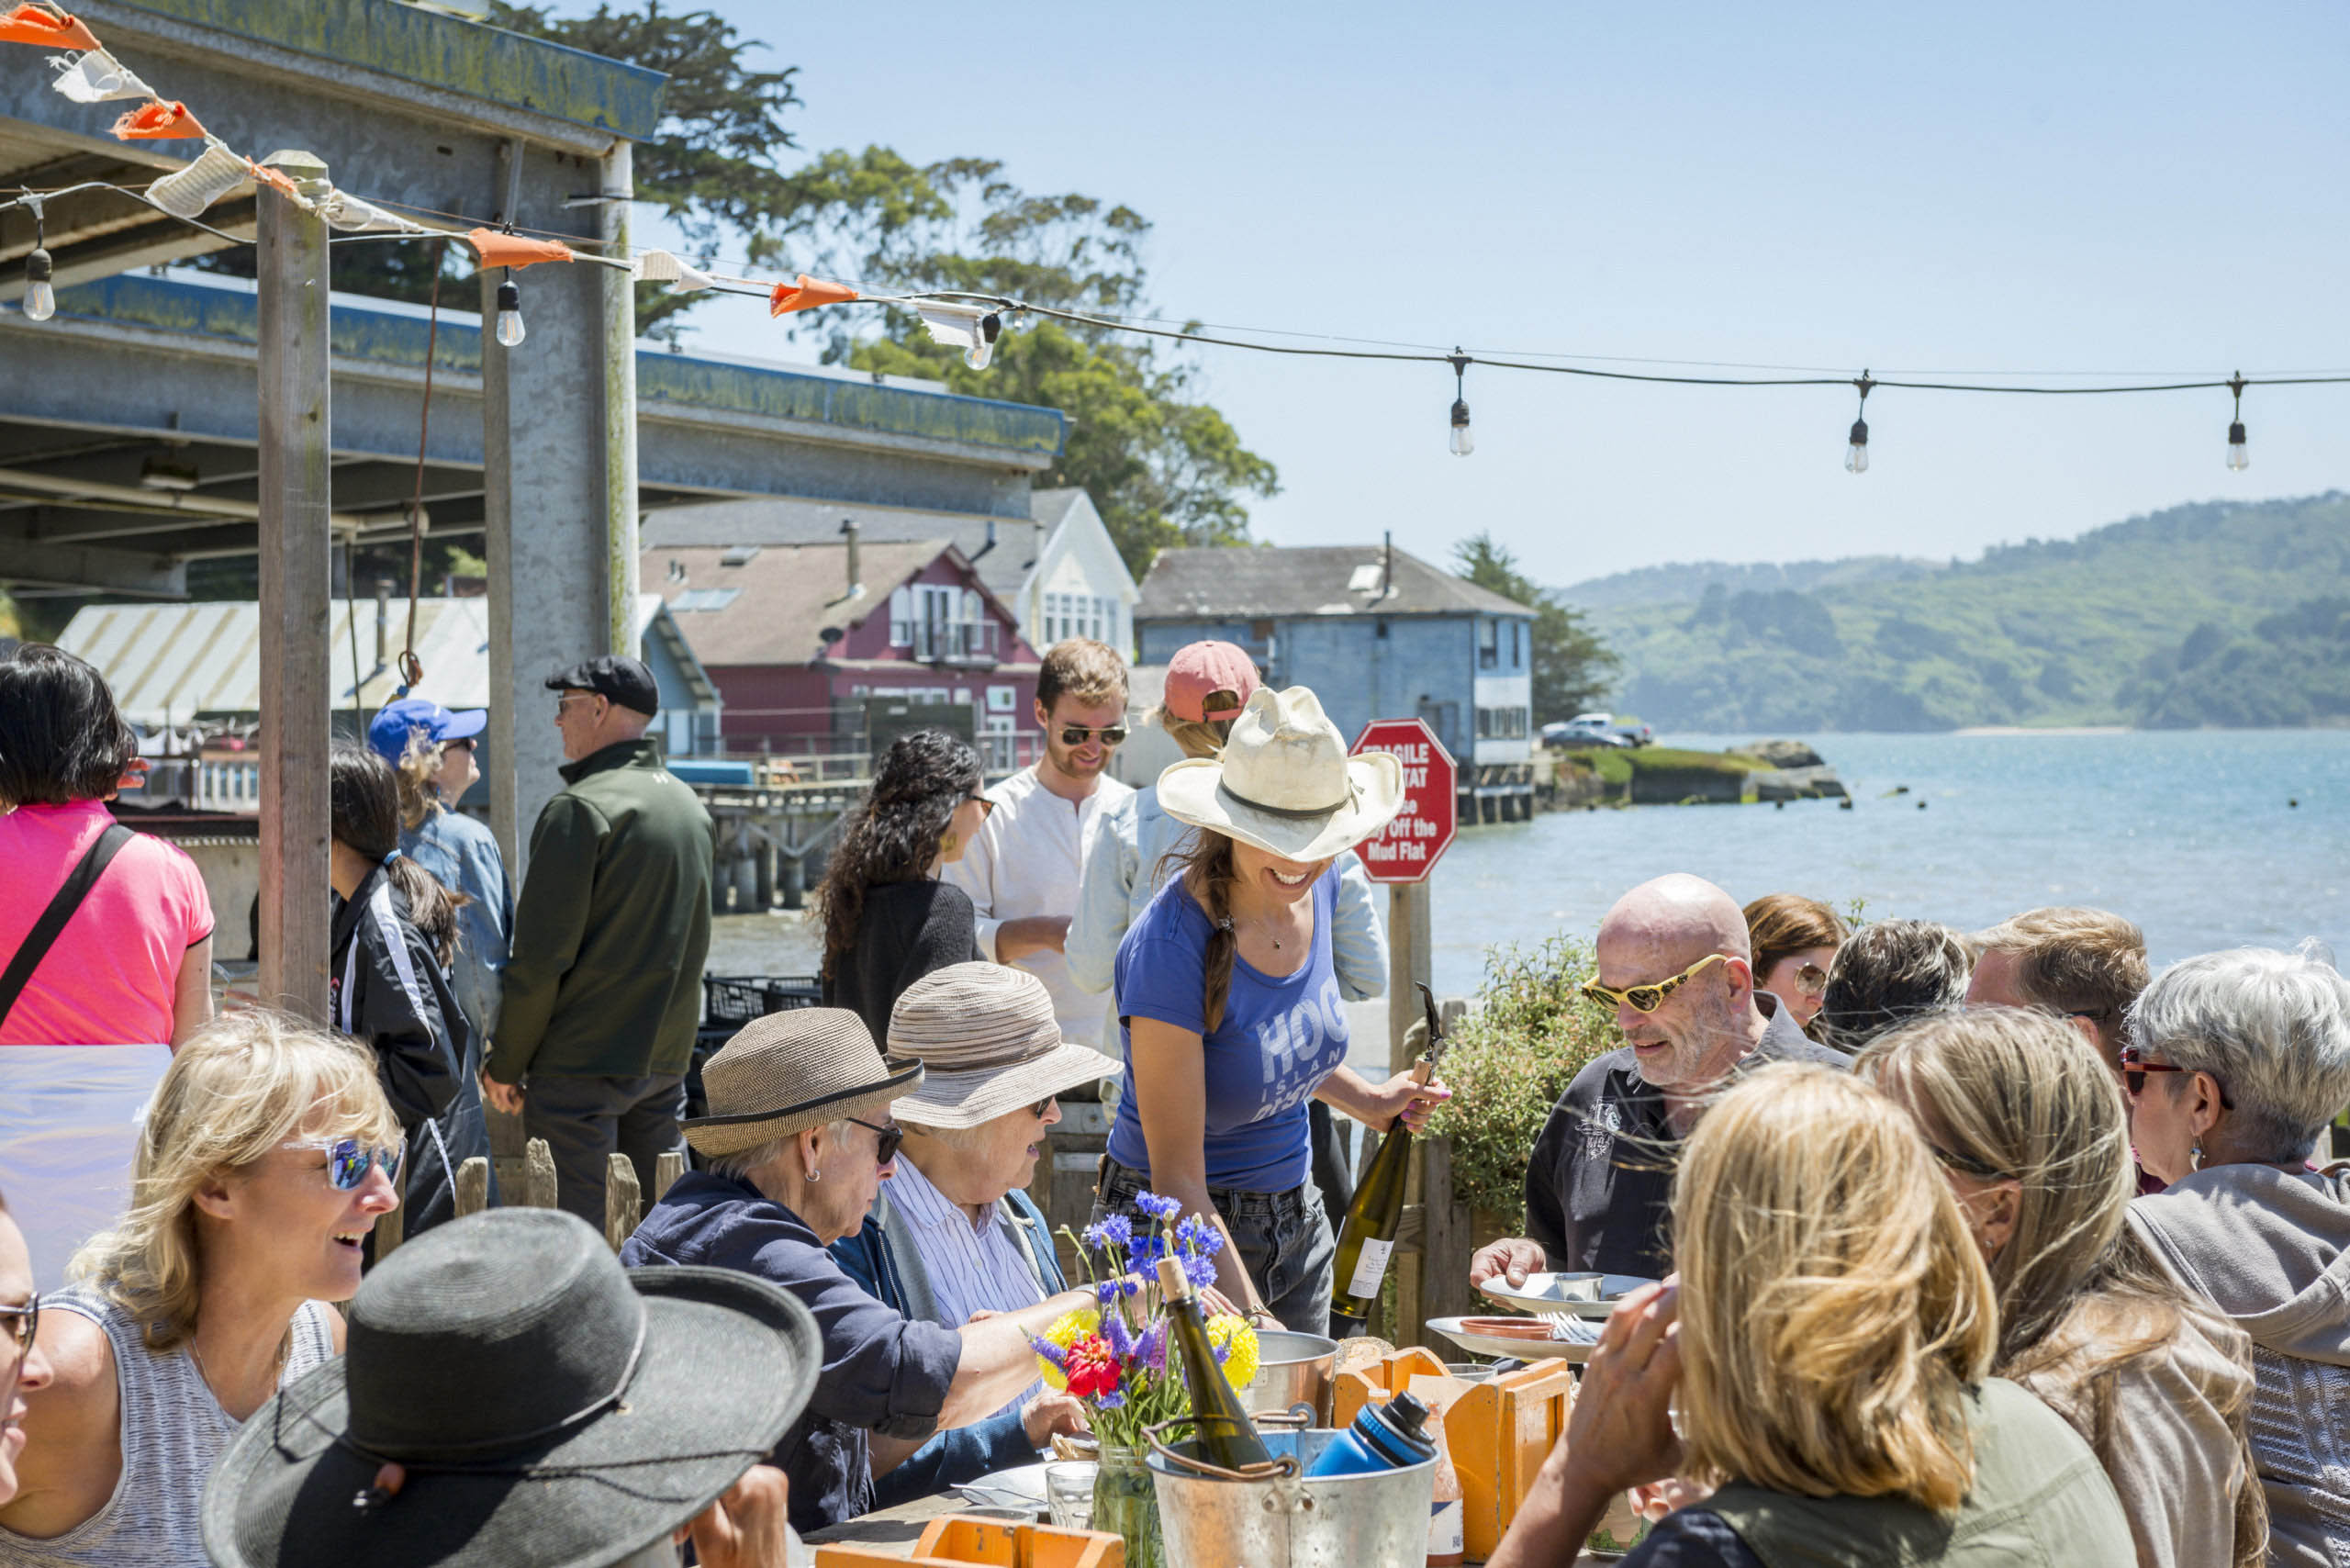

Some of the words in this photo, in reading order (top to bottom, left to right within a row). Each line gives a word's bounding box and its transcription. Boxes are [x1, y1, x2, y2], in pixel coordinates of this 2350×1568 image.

[1388, 817, 1411, 837] Off
[1414, 818, 1437, 837] the
[1367, 841, 1396, 860] Mud
[1399, 841, 1426, 860] Flat
[1261, 1047, 1341, 1103] ISLAN
